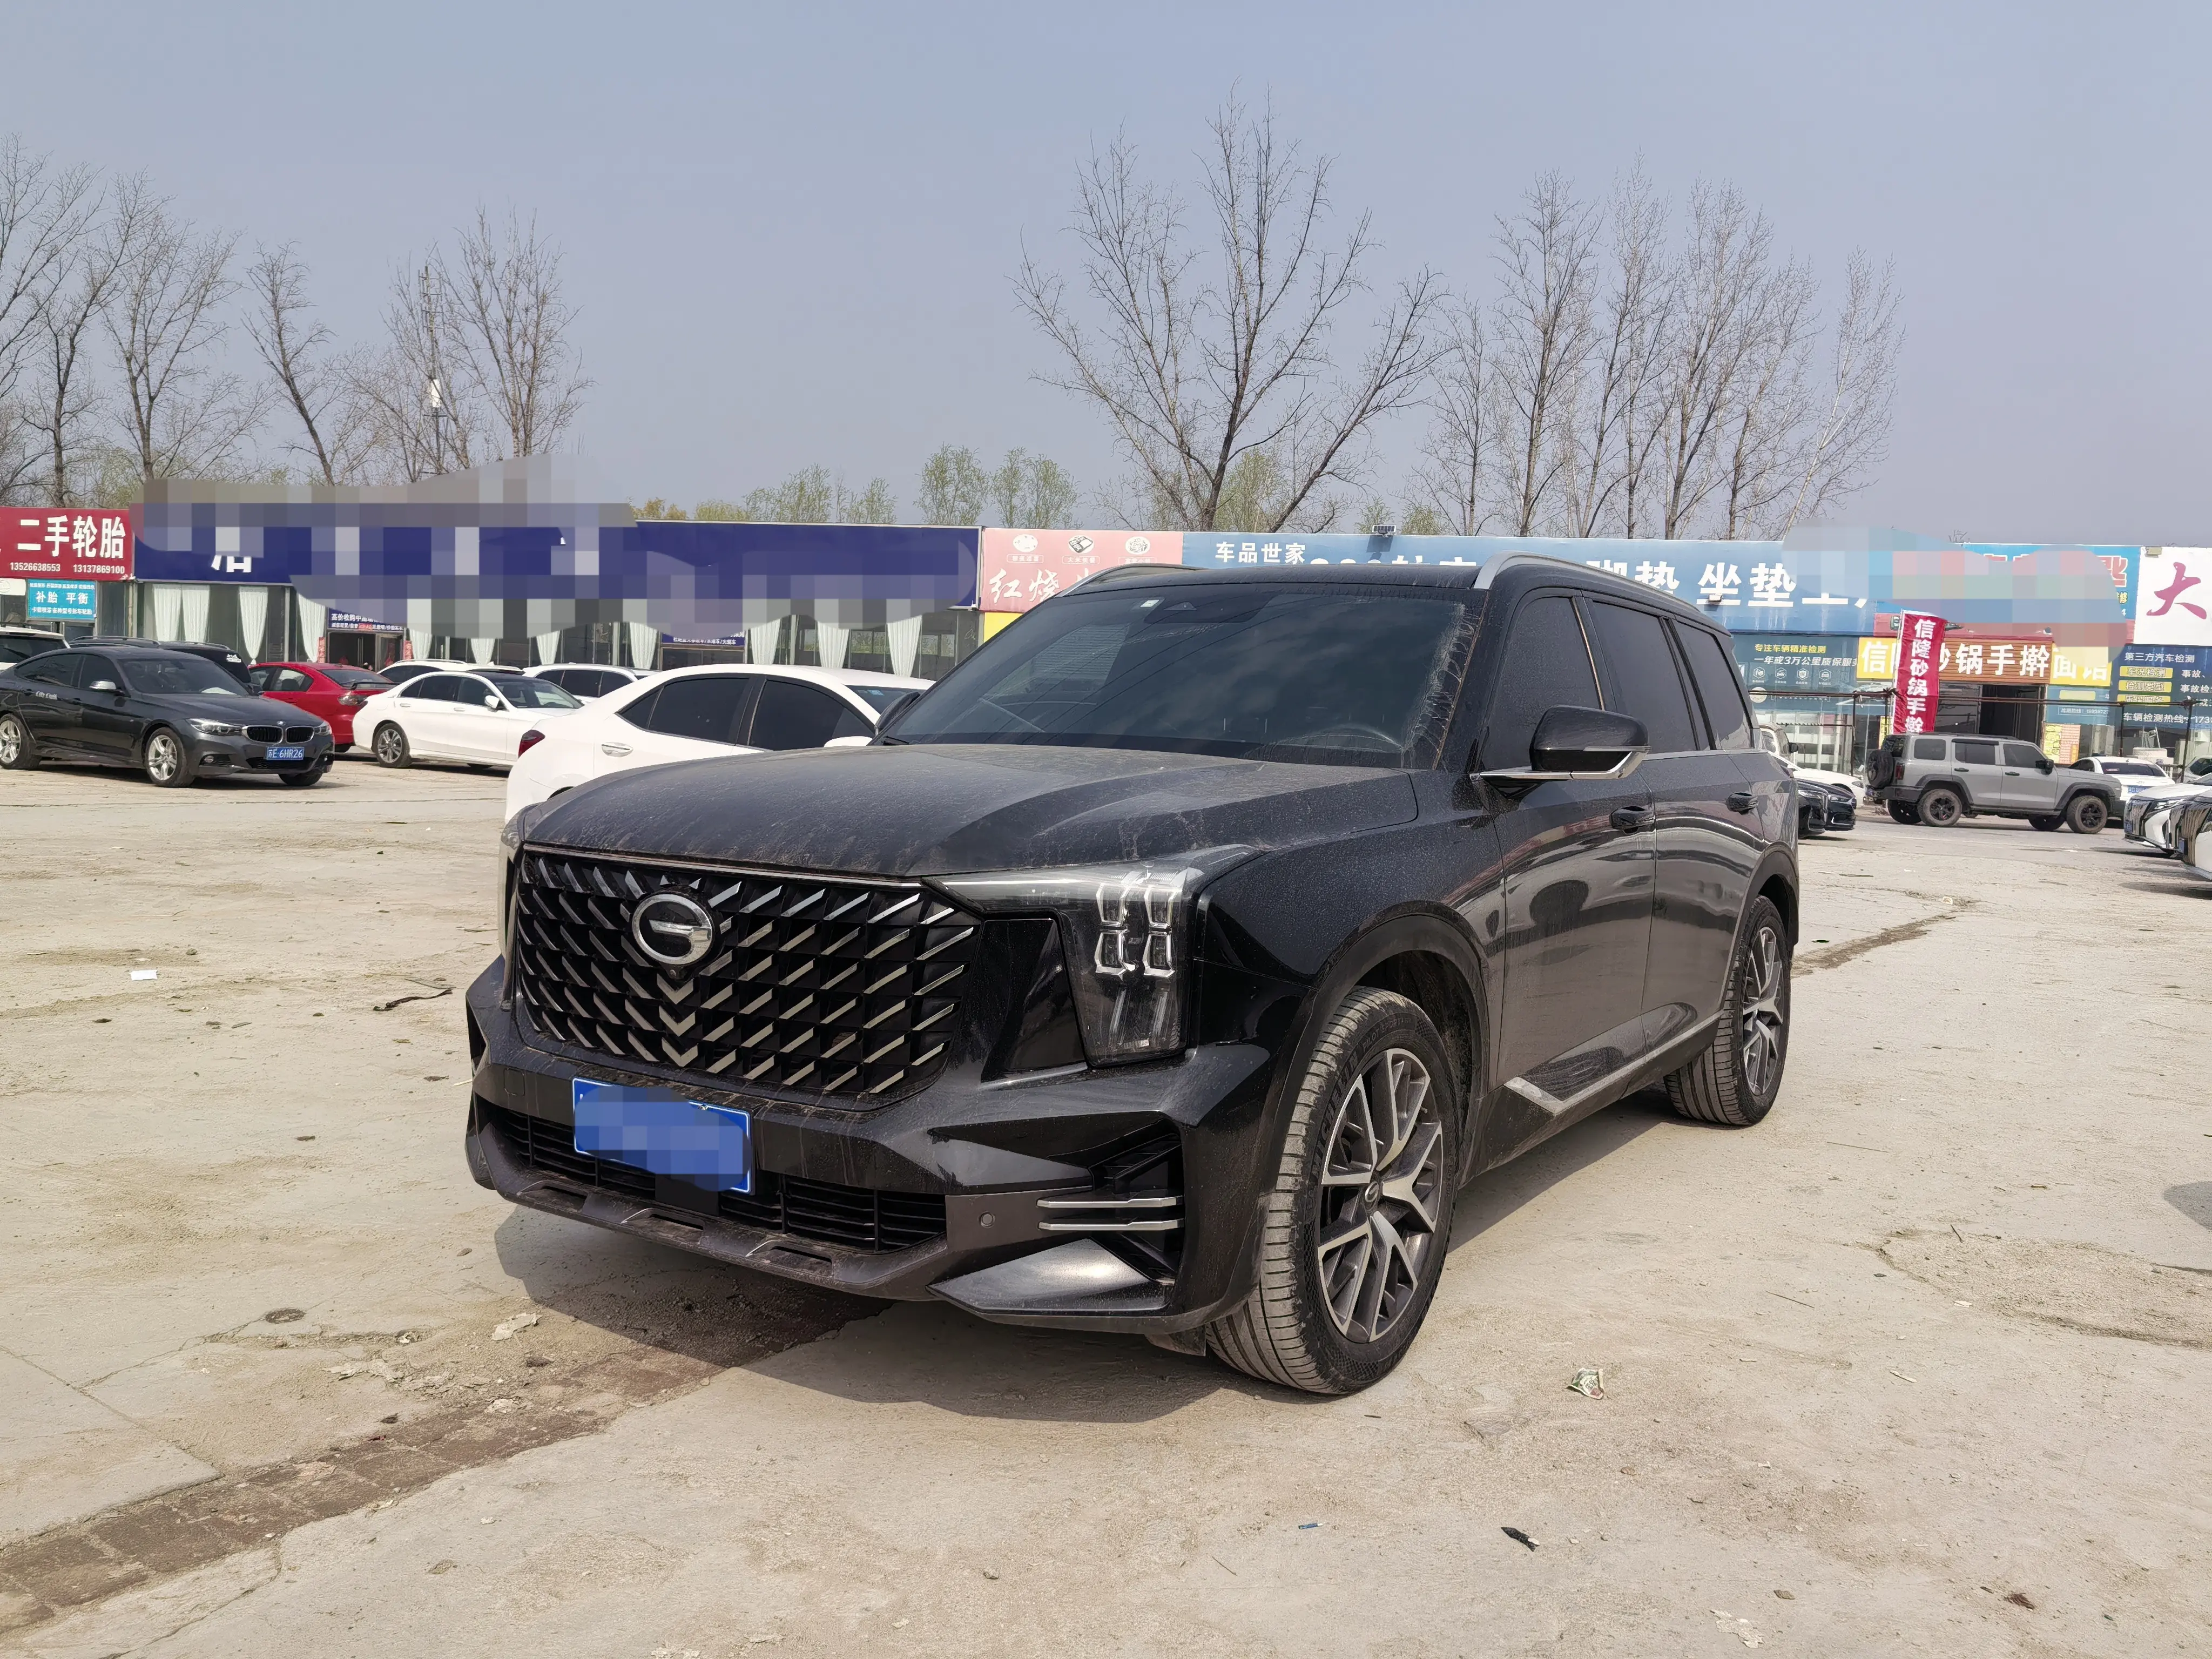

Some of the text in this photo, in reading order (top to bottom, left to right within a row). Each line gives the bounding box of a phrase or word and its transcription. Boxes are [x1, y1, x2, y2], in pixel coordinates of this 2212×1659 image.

[17, 515, 126, 558] 二手轮胎
[1215, 542, 1306, 565] 车品世家
[10, 562, 60, 572] 13526638553
[36, 590, 89, 605] 补胎 平衡
[1755, 644, 1827, 654] 专注车辆精准检测
[2125, 652, 2195, 663] 第三方汽车检测
[2180, 684, 2212, 693] 事故检
